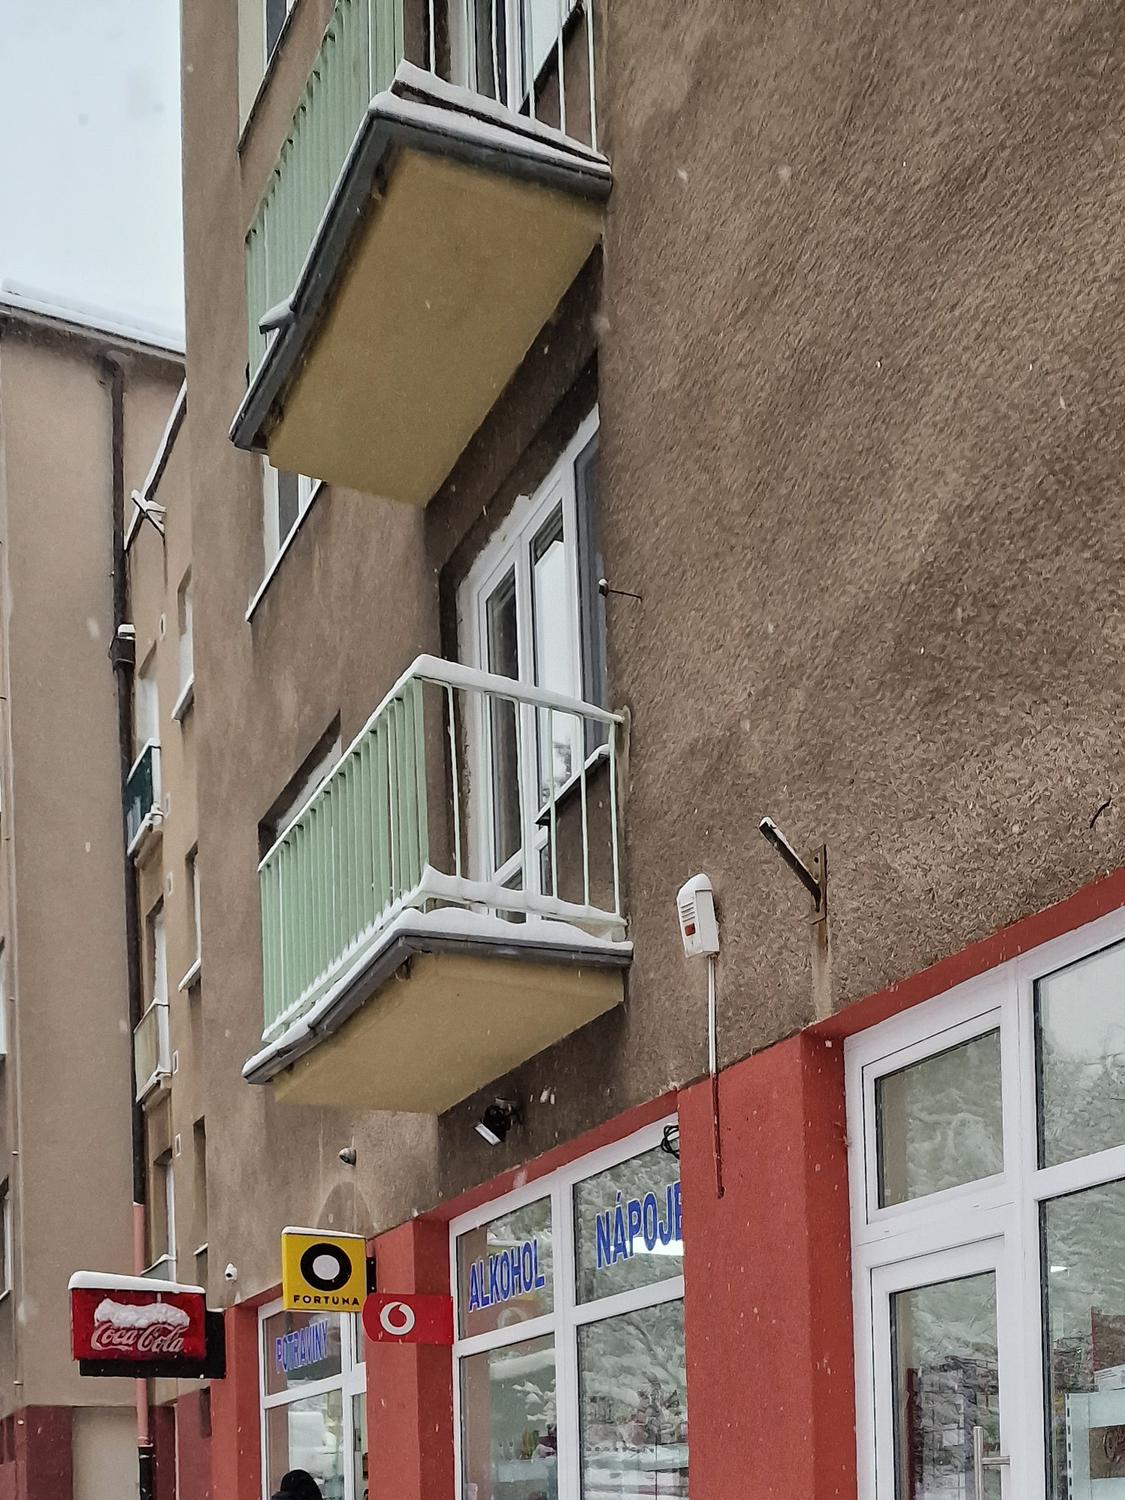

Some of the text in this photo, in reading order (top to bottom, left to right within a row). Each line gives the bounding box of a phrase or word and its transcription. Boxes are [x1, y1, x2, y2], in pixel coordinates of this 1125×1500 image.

[293, 1294, 360, 1306] FORTUNA
[468, 1239, 545, 1313] ALKOHOL
[275, 1318, 328, 1375] POTRAVINY
